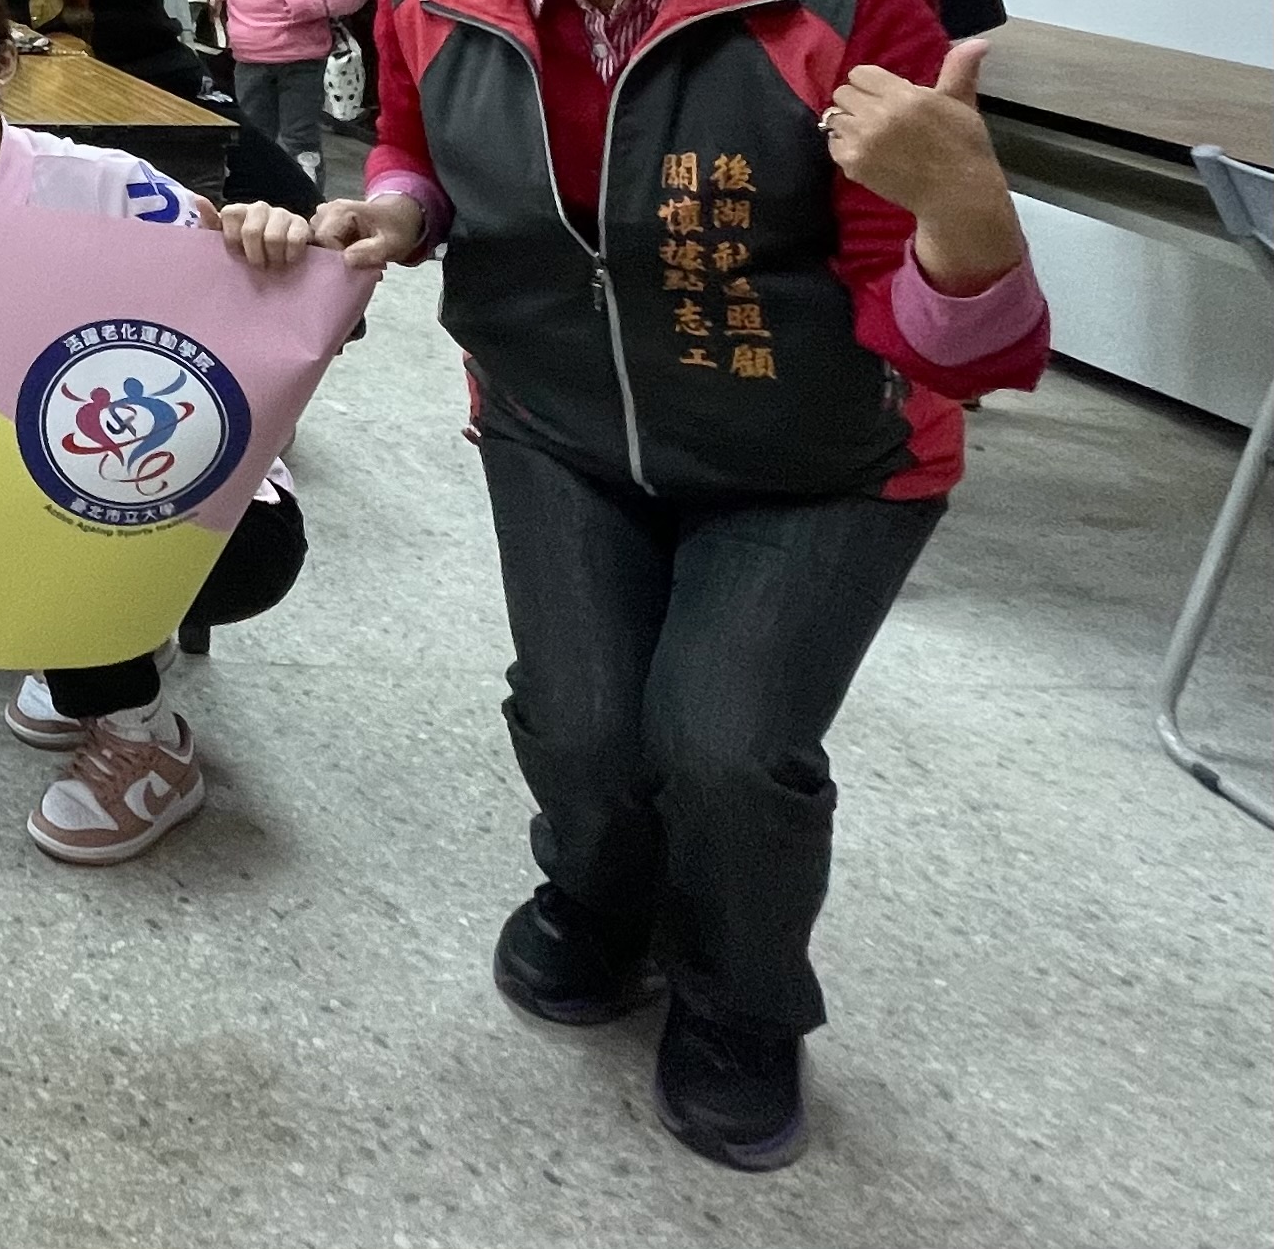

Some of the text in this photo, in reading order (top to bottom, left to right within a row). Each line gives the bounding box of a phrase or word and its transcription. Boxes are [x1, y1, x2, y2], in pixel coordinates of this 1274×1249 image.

[64, 323, 215, 373] 活躍老化運動學院
